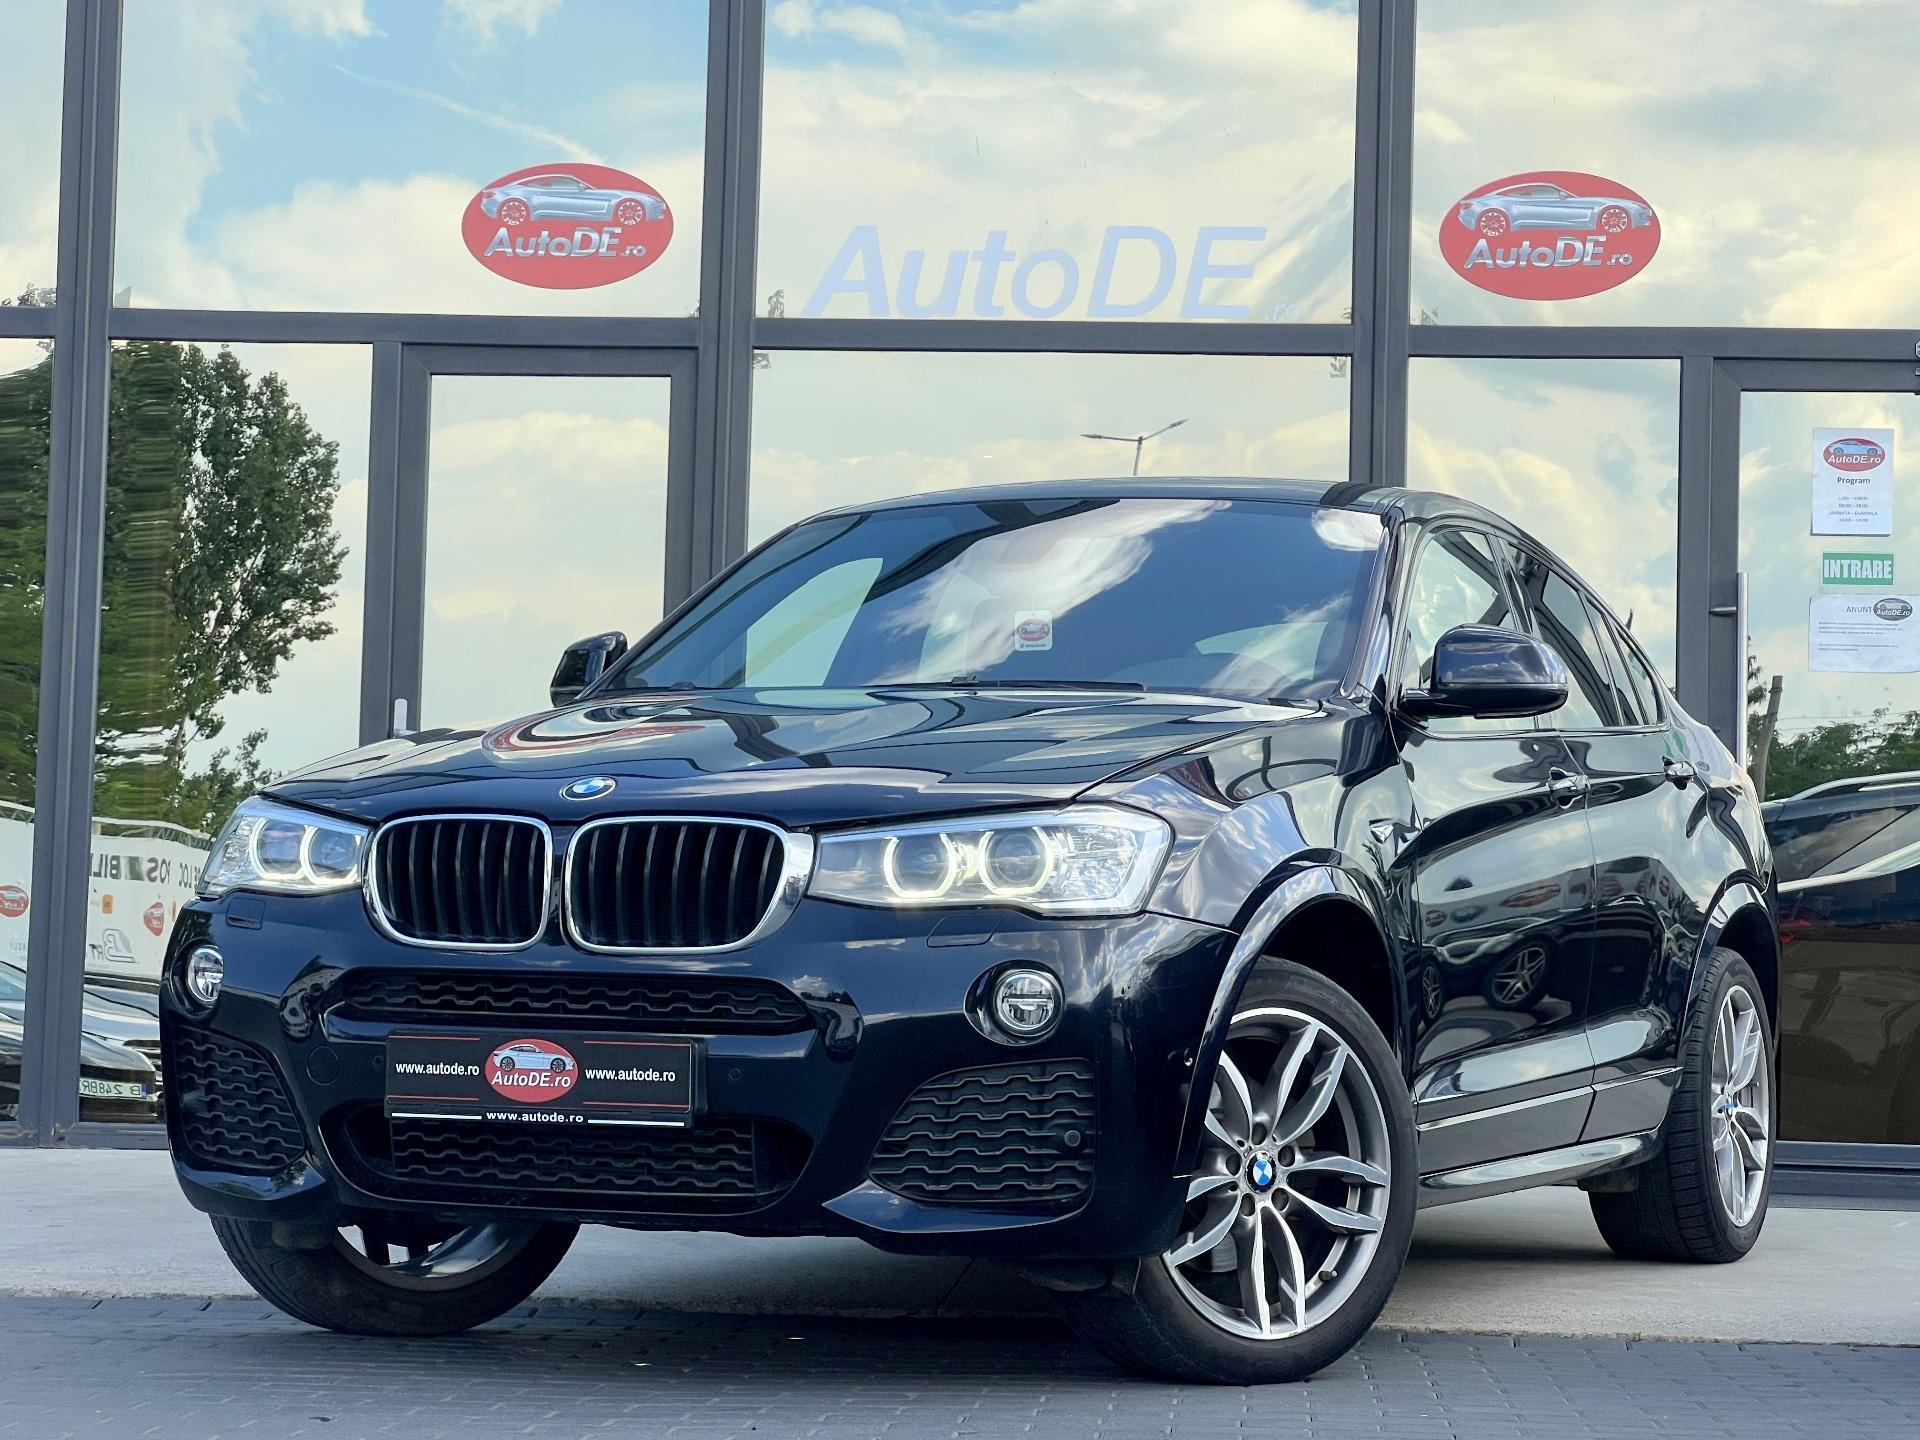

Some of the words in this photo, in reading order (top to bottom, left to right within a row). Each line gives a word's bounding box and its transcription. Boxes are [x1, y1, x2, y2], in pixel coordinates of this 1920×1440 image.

[1836, 476, 1871, 486] Program
[1823, 559, 1893, 580] INTRARE
[395, 1062, 480, 1076] www.autode.ro
[585, 1067, 676, 1082] www.autode.ro
[491, 1071, 571, 1088] AutoDE.ro
[486, 1111, 584, 1123] www.autode.ro
